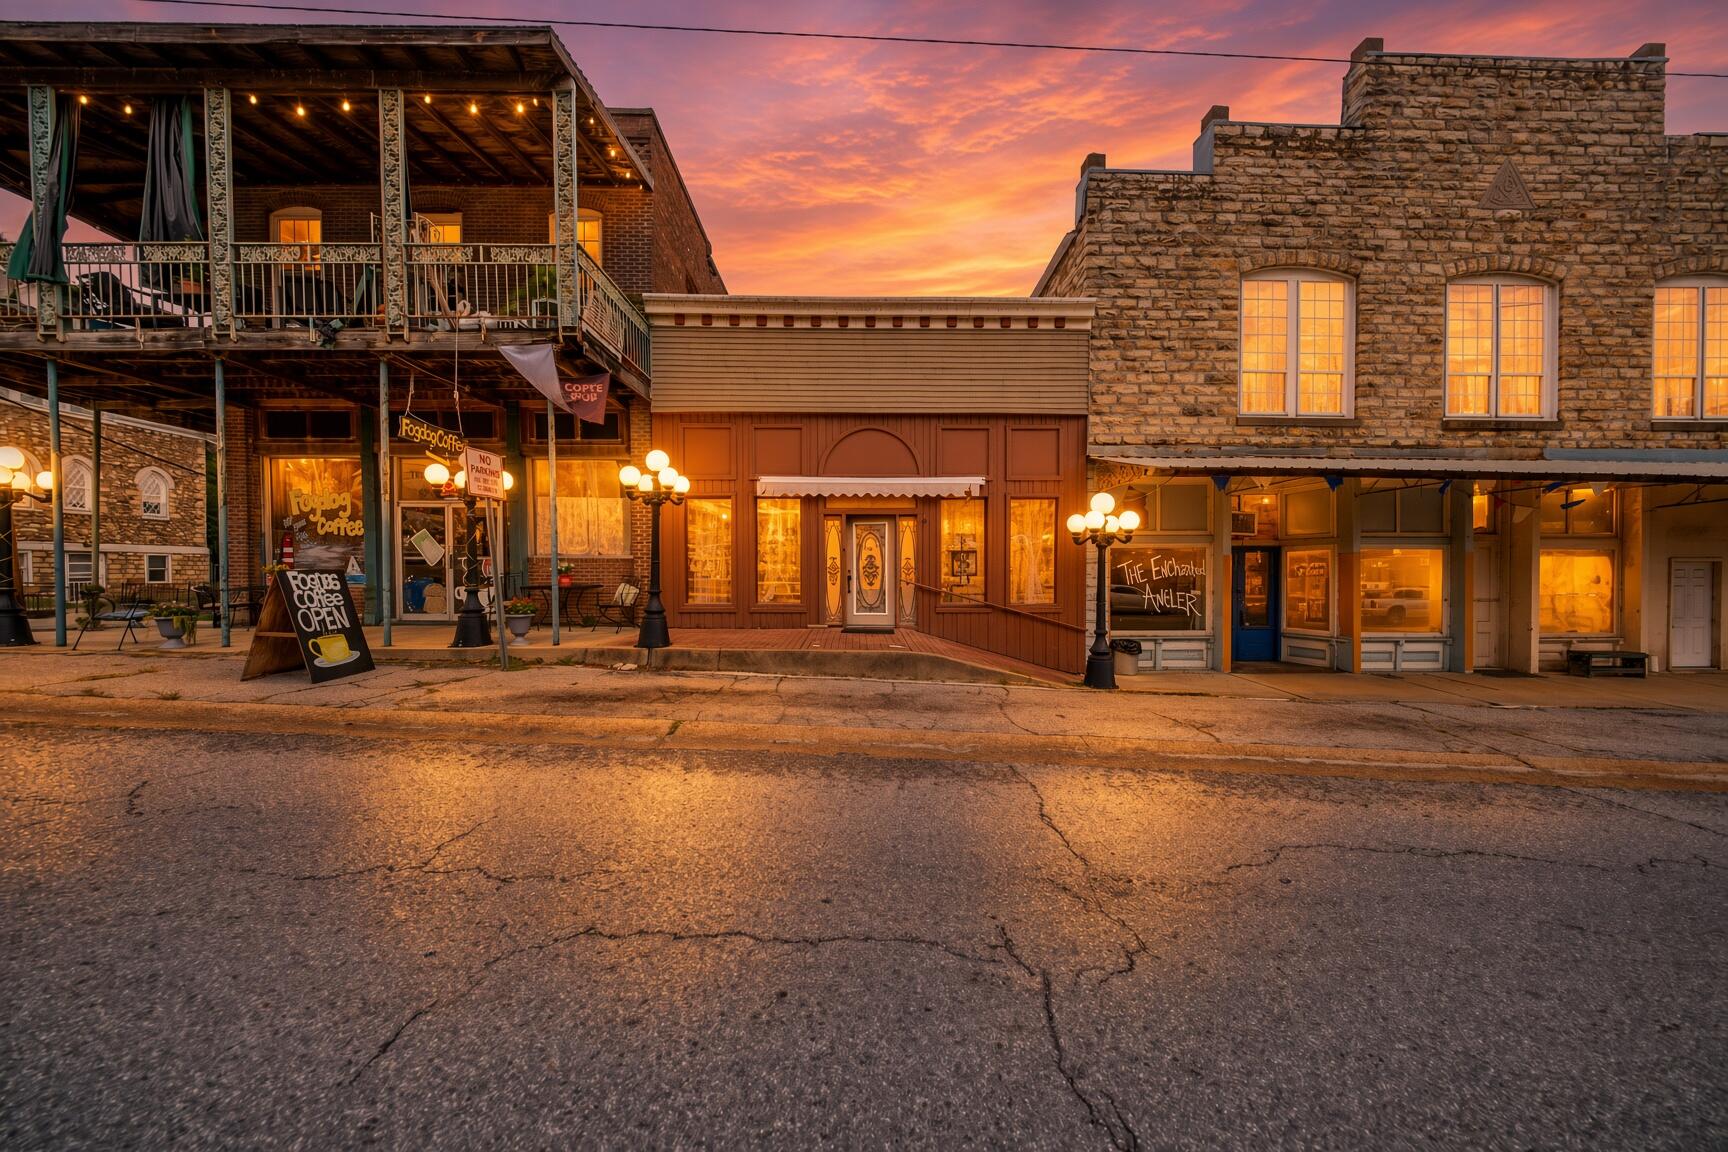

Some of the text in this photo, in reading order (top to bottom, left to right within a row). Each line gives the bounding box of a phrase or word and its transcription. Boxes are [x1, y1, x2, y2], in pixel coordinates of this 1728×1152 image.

[479, 454, 492, 466] NO
[316, 516, 365, 536] Coffee
[1117, 560, 1148, 585] THE
[297, 606, 351, 632] OPEN
